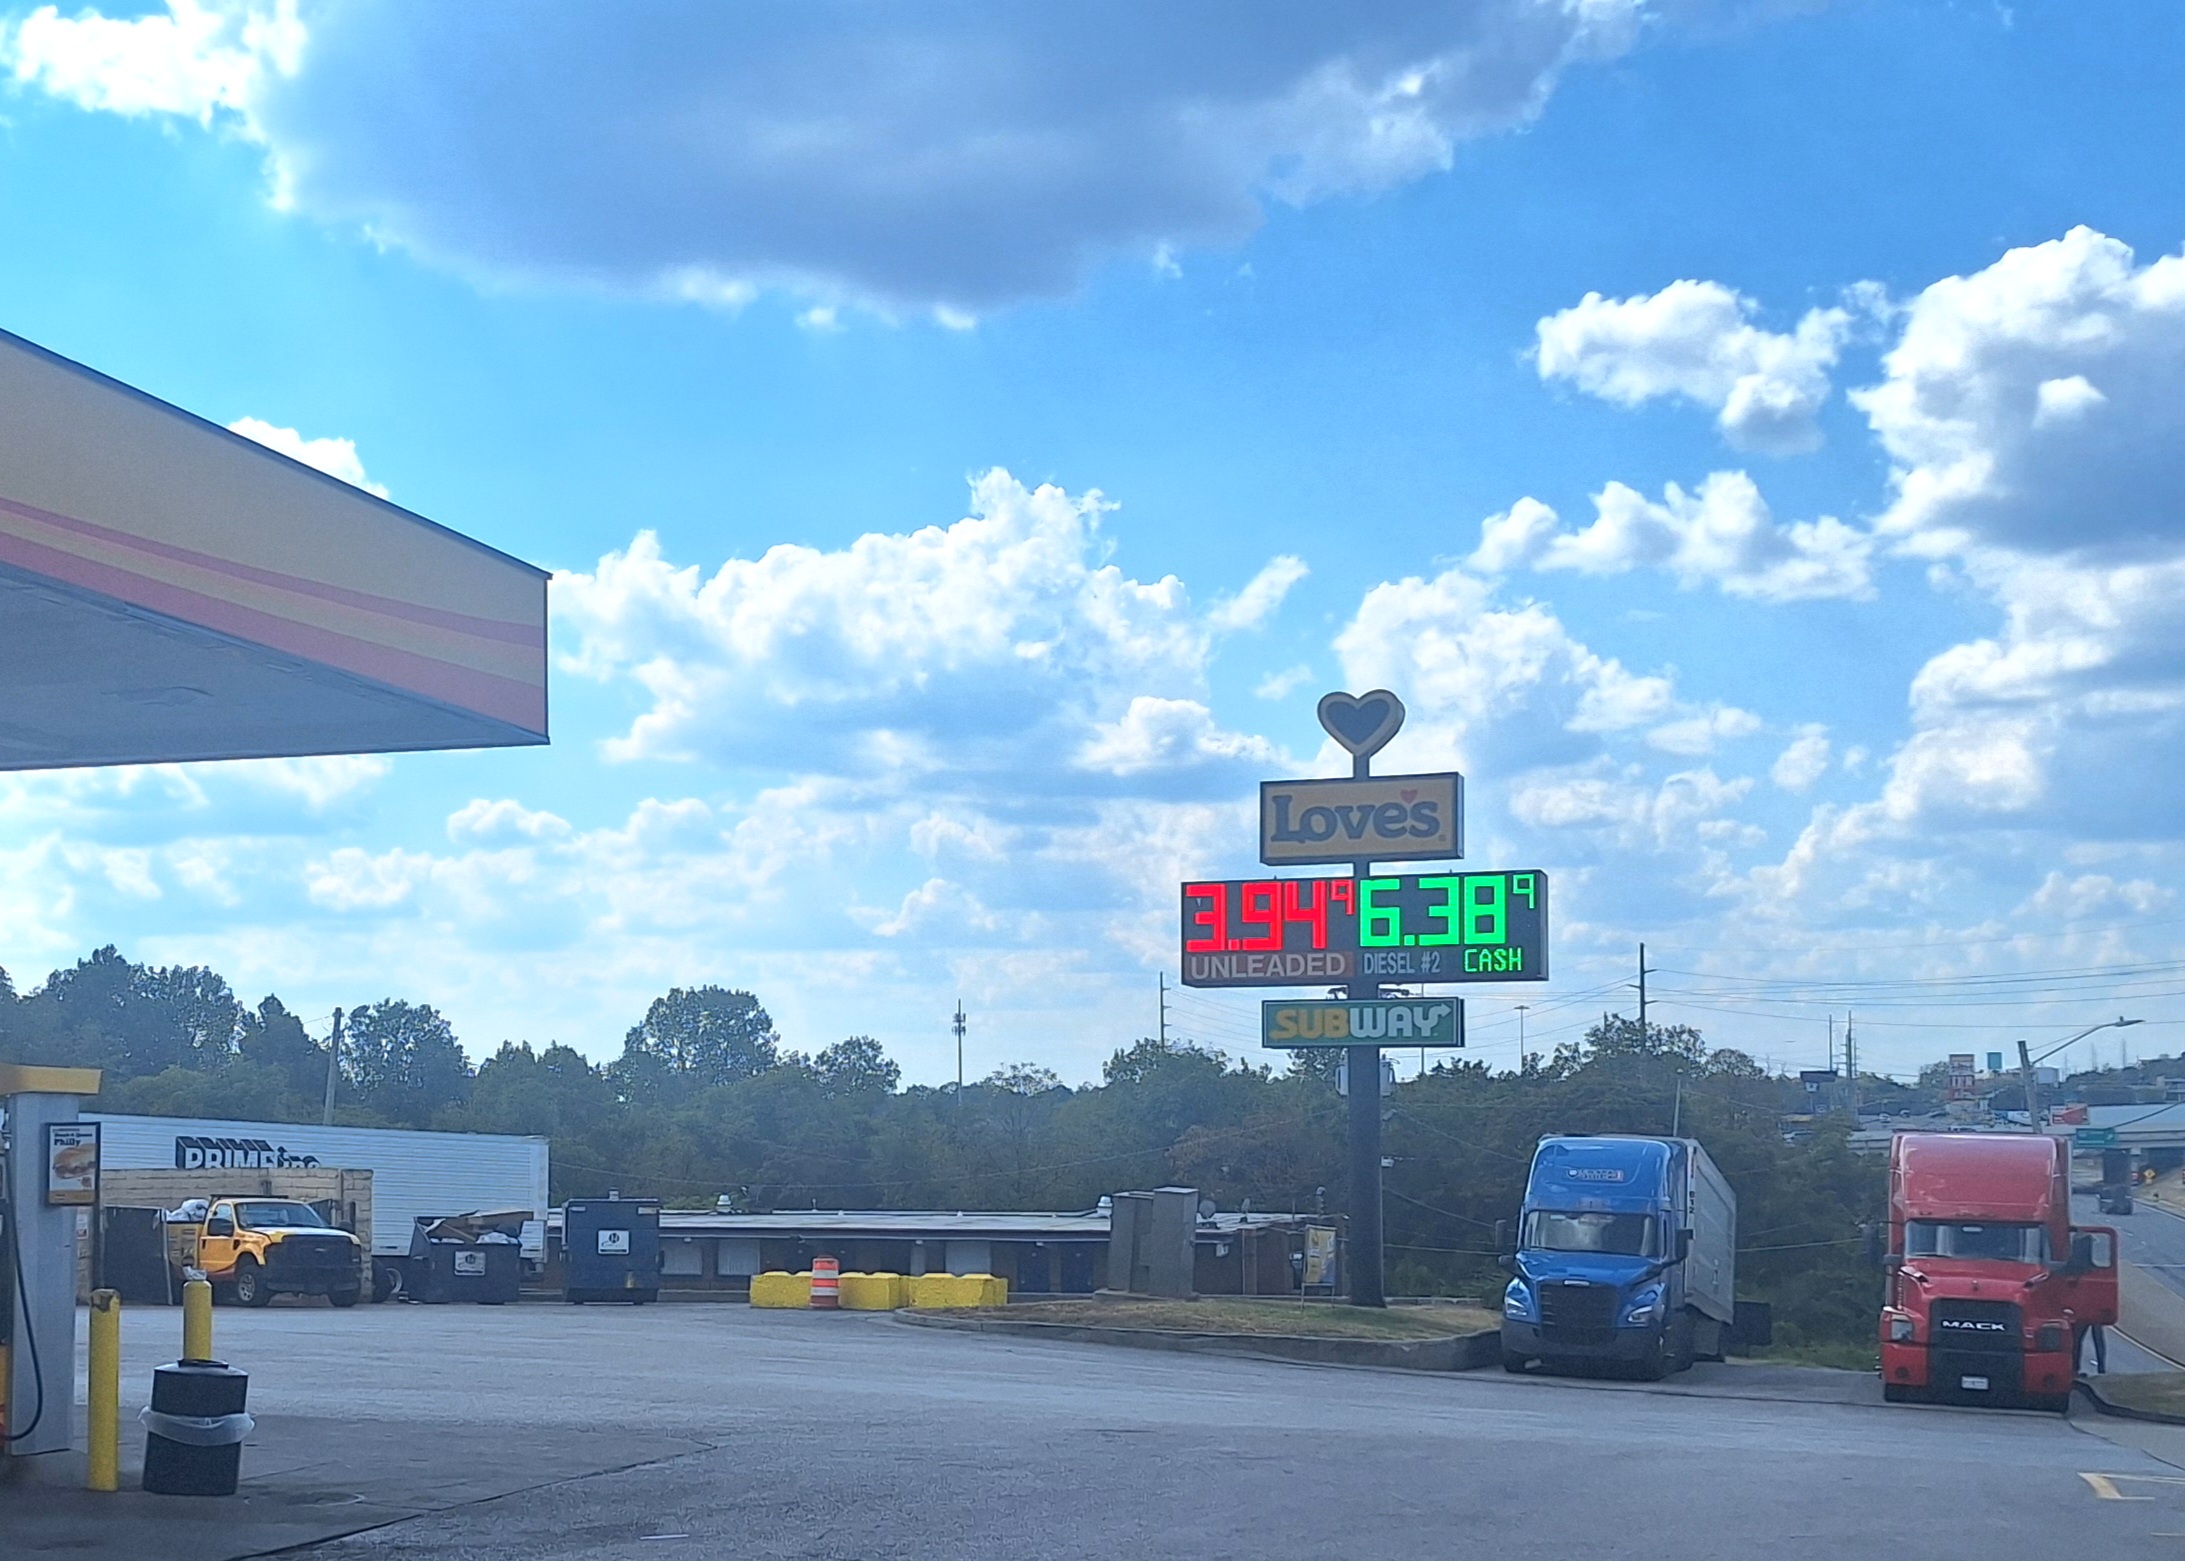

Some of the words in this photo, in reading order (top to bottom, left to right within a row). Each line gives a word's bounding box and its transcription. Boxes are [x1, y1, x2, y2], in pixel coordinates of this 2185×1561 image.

[1191, 952, 1345, 979] UNLEADED
[1364, 952, 1415, 974] DIESEL
[1421, 951, 1441, 973] #2
[1464, 947, 1522, 972] CASH
[1268, 1002, 1452, 1040] SUBWAY
[1942, 1320, 2005, 1331] MACK
